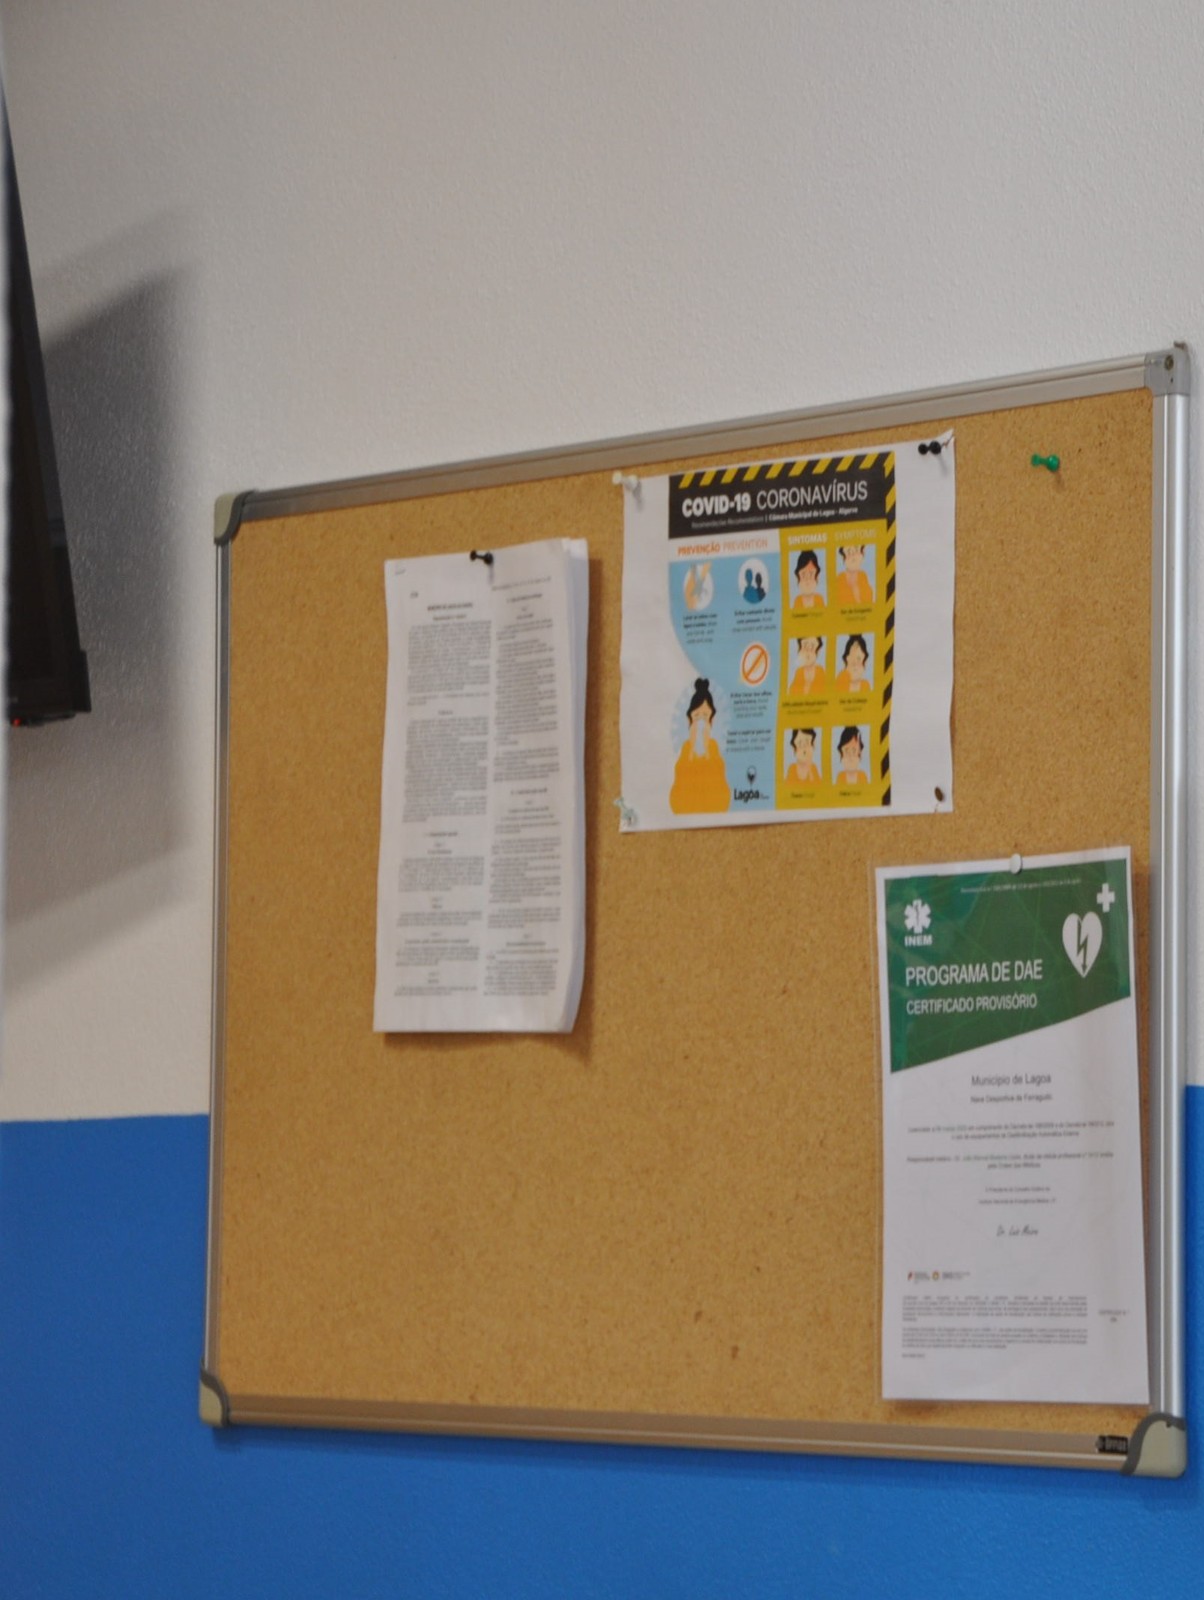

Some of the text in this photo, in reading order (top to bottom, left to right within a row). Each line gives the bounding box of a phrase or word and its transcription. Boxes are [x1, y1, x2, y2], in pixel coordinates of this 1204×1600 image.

[681, 479, 868, 518] COVID-19 CORONAVÍRUS
[788, 532, 827, 544] SINTOMAS
[678, 538, 768, 557] PREVENÇÃO PREVENTION
[733, 788, 760, 803] Lagoa
[904, 934, 933, 947] INEM
[905, 959, 1043, 987] PROGRAMA DE DAE
[906, 992, 1038, 1015] CERTIFICADO PROVISÓRIO
[971, 1073, 1052, 1087] Município de Lagoa
